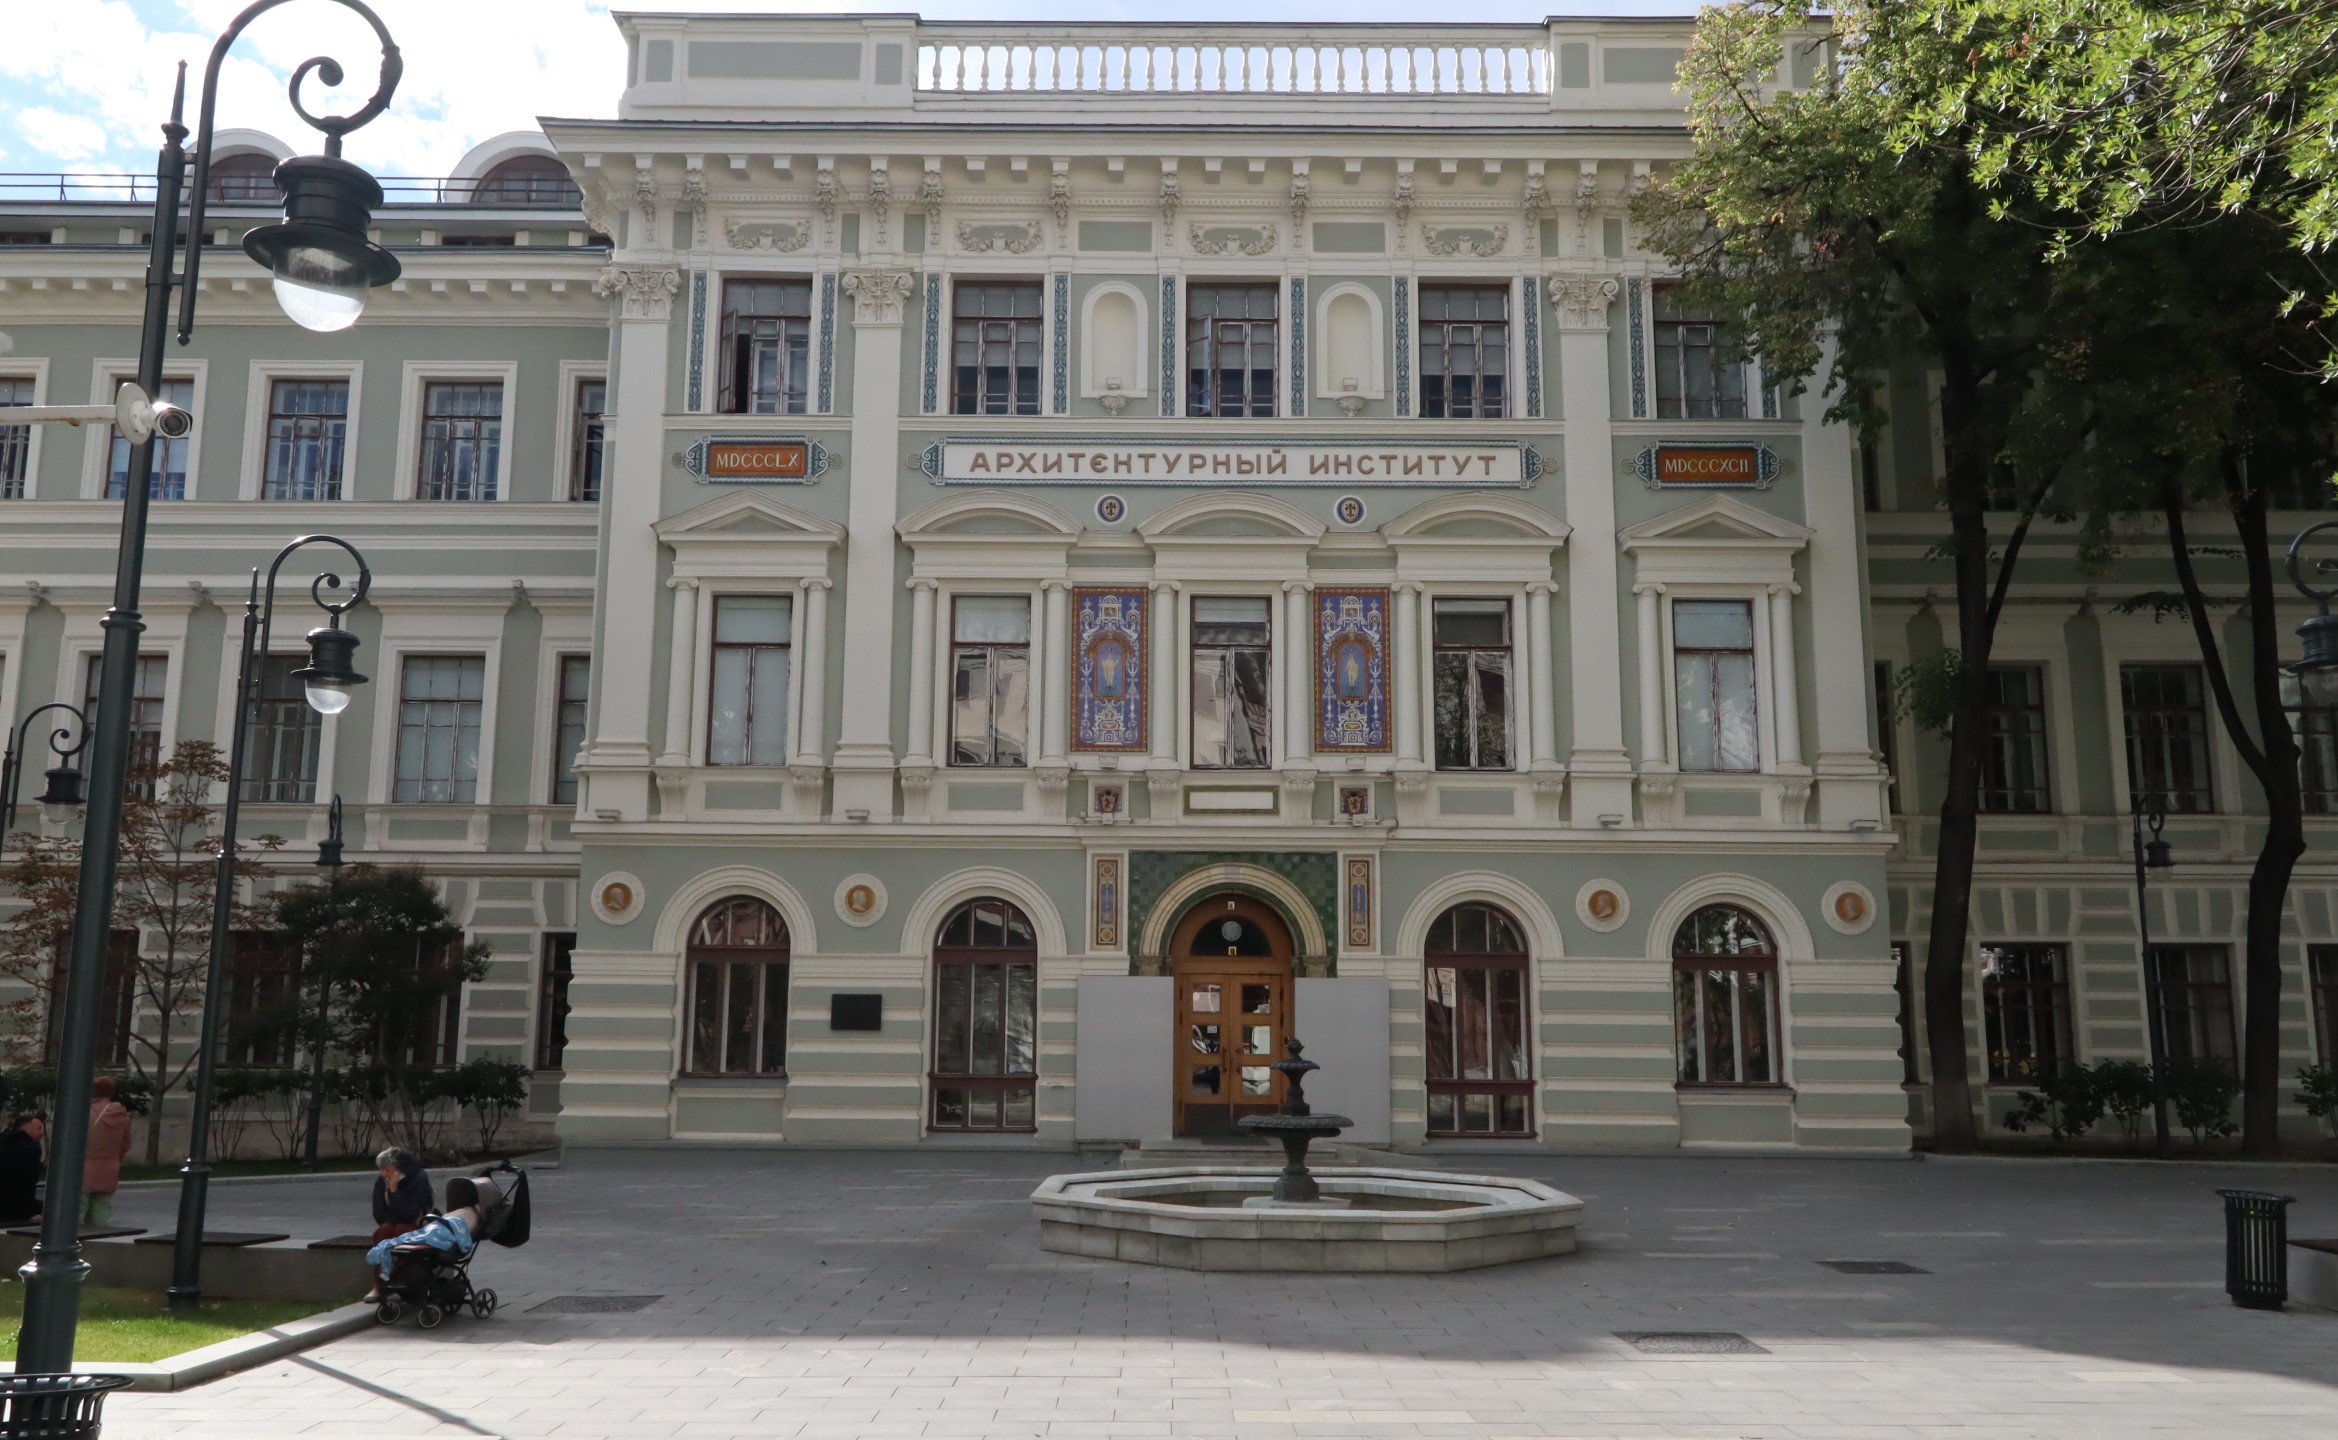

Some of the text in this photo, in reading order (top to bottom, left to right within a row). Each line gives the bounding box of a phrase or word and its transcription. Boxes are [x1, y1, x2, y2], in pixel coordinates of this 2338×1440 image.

[715, 453, 799, 468] MDCCCLX
[1308, 454, 1497, 476] ИНСТИТУТ
[1664, 458, 1749, 473] MDCCCXCII
